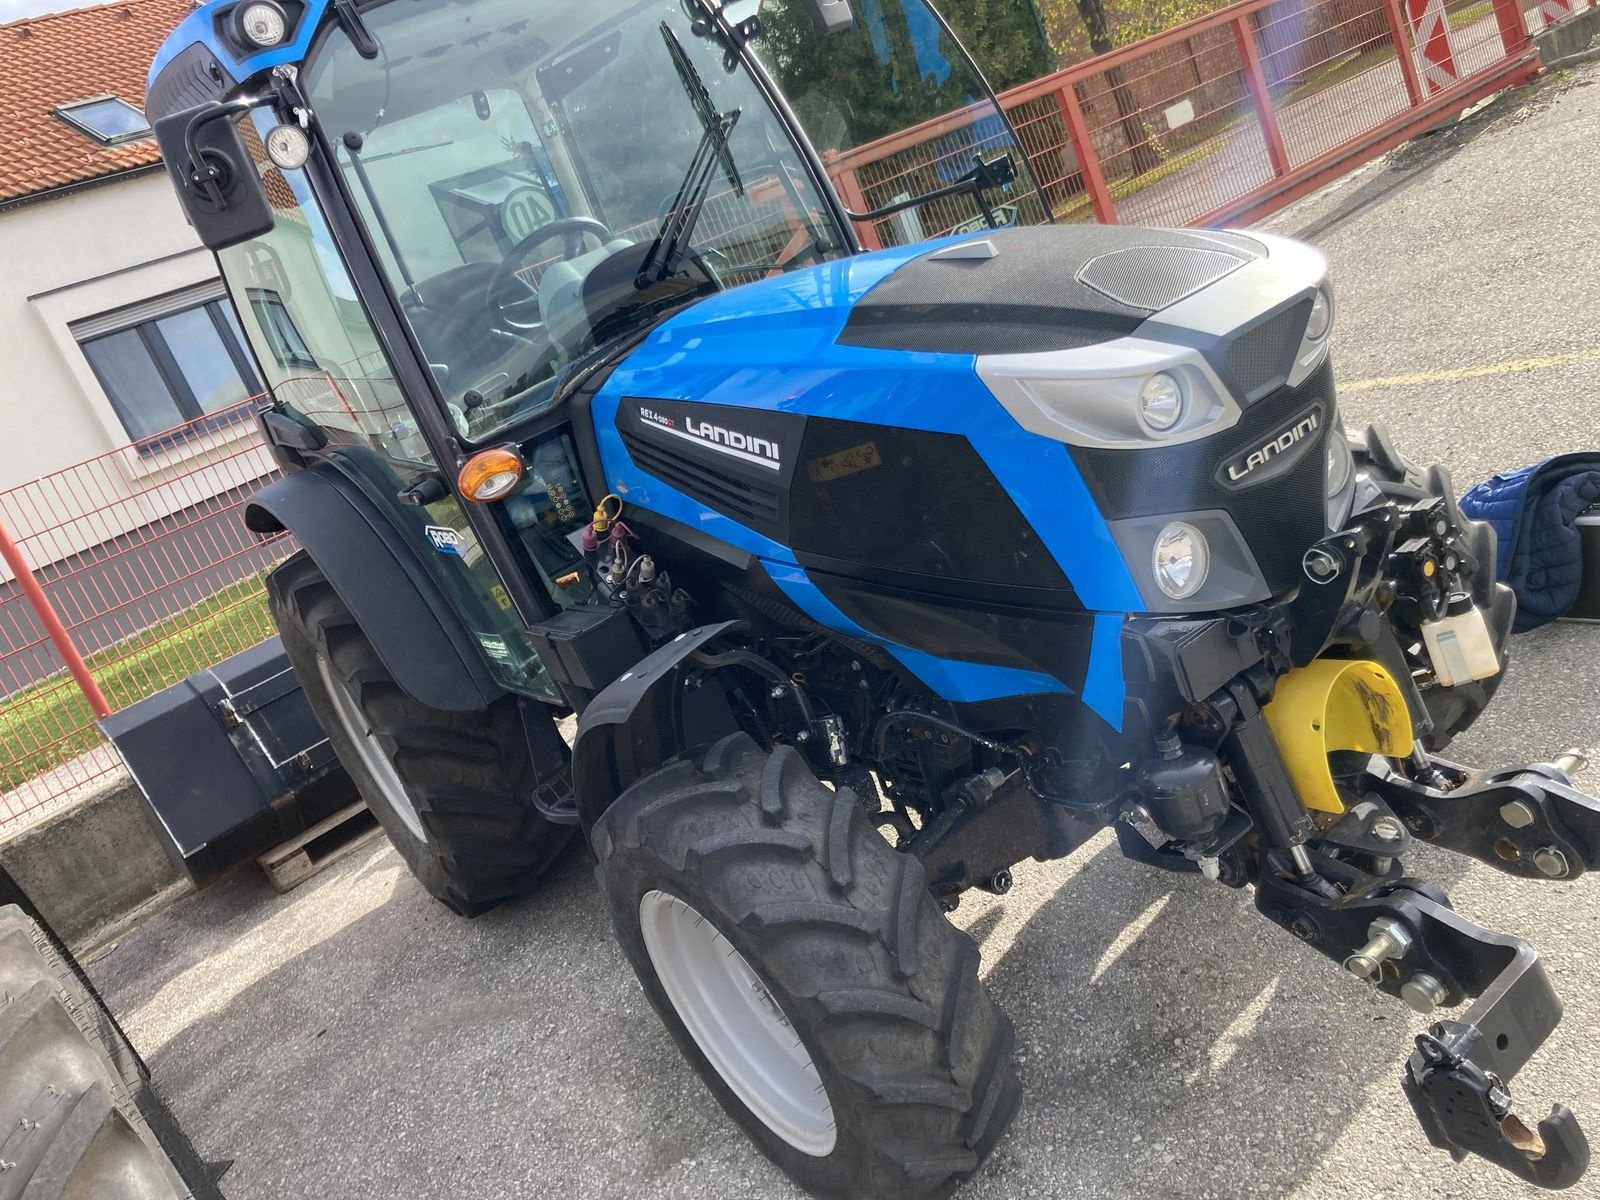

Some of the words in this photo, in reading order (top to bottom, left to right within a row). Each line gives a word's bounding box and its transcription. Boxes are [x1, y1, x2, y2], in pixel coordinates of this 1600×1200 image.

[640, 407, 653, 420] REX
[685, 416, 780, 460] LANDINI
[1227, 414, 1318, 481] LANDINI
